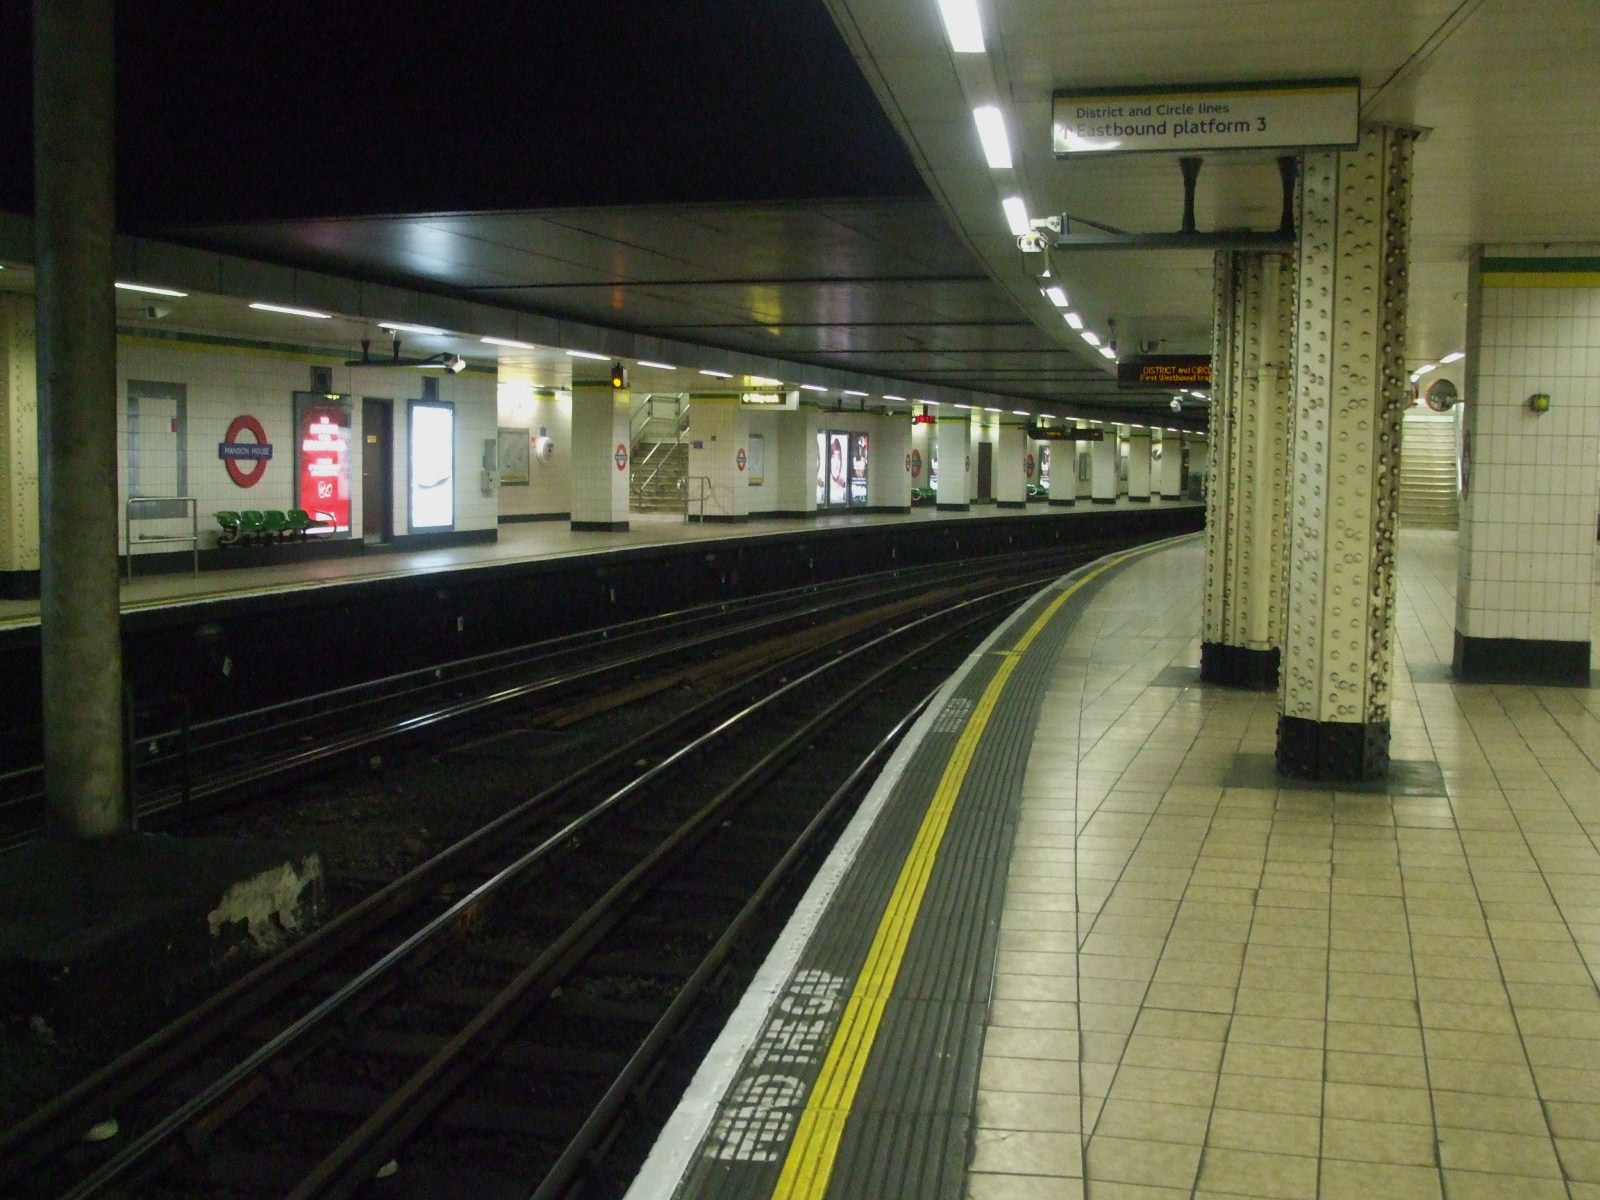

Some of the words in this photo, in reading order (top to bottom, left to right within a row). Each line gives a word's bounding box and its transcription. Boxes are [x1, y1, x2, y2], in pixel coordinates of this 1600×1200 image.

[1076, 106, 1124, 118] District
[1129, 105, 1151, 117] and
[1157, 104, 1194, 116] Circle
[1198, 103, 1230, 115] lines
[1076, 121, 1167, 137] Eastbound
[1173, 119, 1250, 138] platform
[1257, 117, 1267, 131] 3
[1143, 366, 1176, 375] DISTRICT
[225, 447, 250, 455] MANSION
[252, 448, 270, 456] HOUSE
[781, 968, 850, 1015] GAP
[751, 1019, 832, 1068] THE
[704, 1074, 806, 1162] MIND
